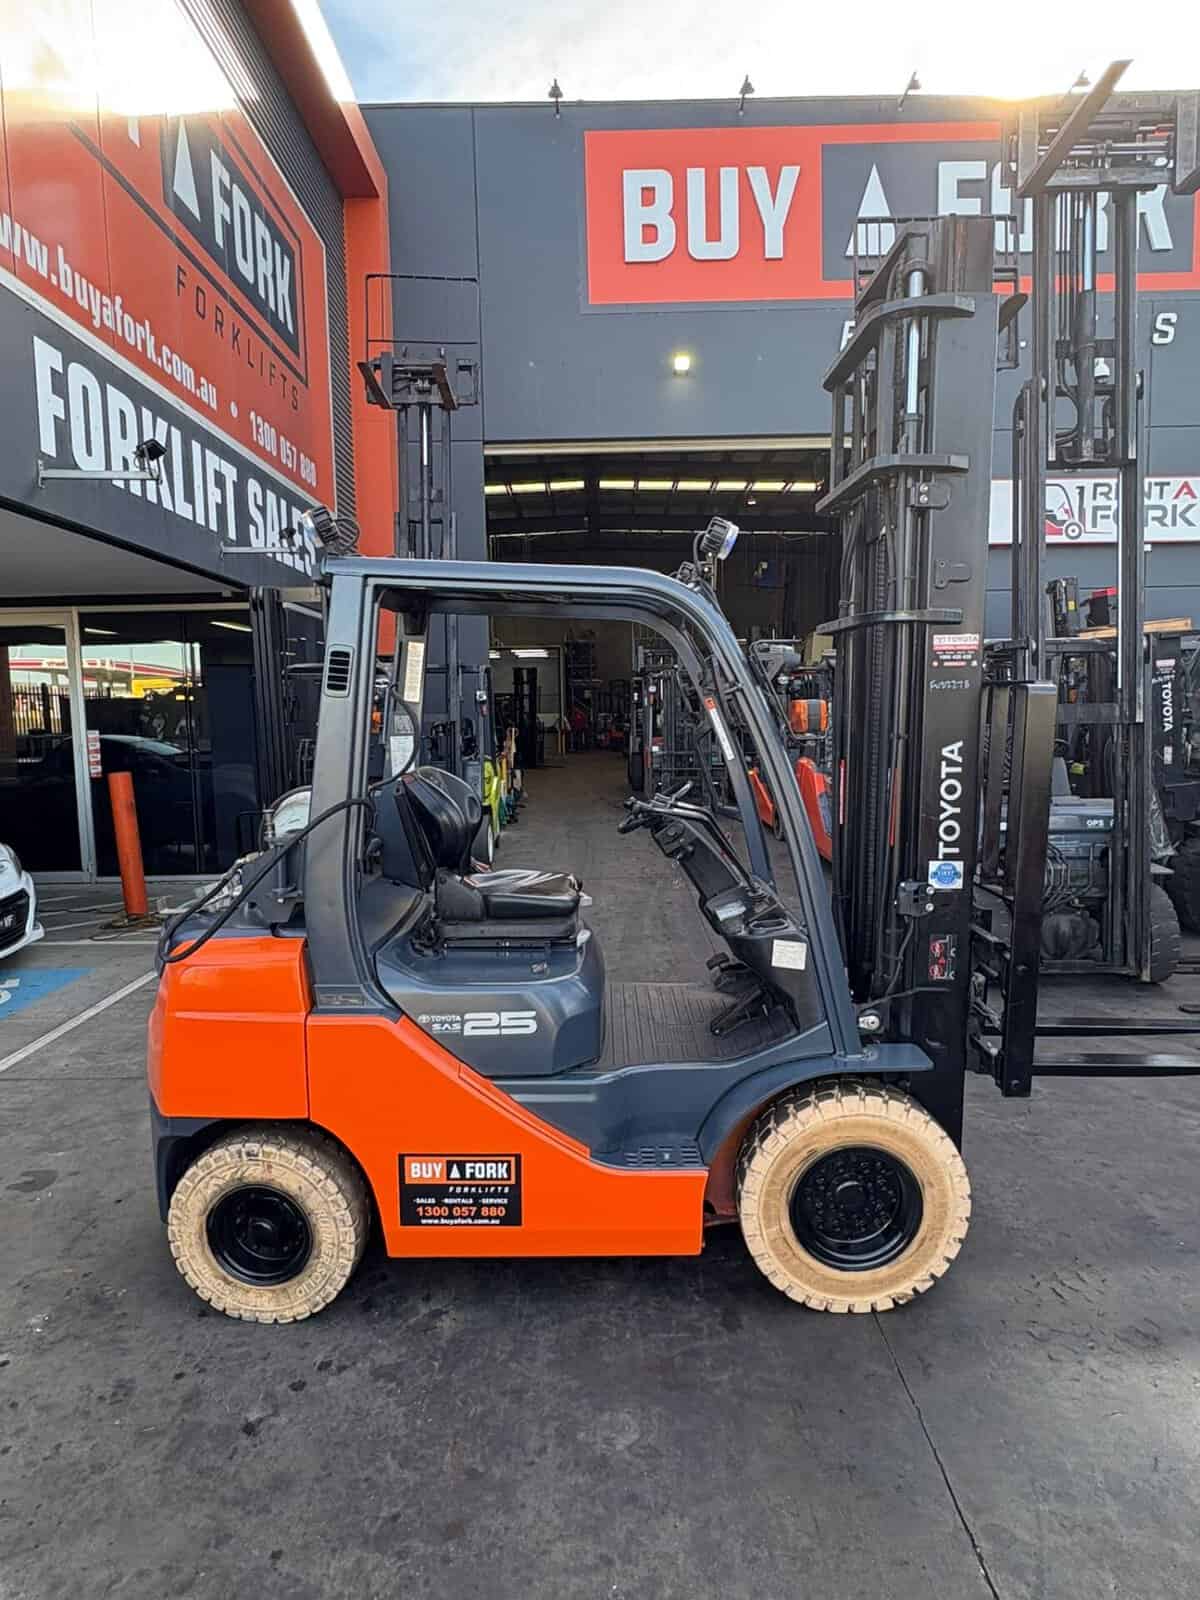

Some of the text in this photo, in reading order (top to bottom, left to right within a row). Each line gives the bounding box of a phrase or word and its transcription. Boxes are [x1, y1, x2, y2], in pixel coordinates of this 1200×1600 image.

[622, 165, 801, 263] BUY
[210, 148, 295, 336] FORK
[175, 264, 299, 411] FORKLIFTS
[32, 335, 317, 578] FORKLIFT SALES
[250, 410, 277, 457] 1300
[279, 434, 298, 473] 057
[1091, 503, 1198, 529] FRK
[1161, 681, 1174, 732] TOYOTA
[938, 740, 963, 860] TOYOTA
[430, 1014, 461, 1023] TOYOTA
[463, 1010, 538, 1036] 25
[410, 1162, 442, 1179] BUY
[464, 1162, 508, 1179] FORK
[448, 1186, 510, 1194] FORKLIFTS
[416, 1206, 449, 1217] 1300
[452, 1206, 478, 1217] 057
